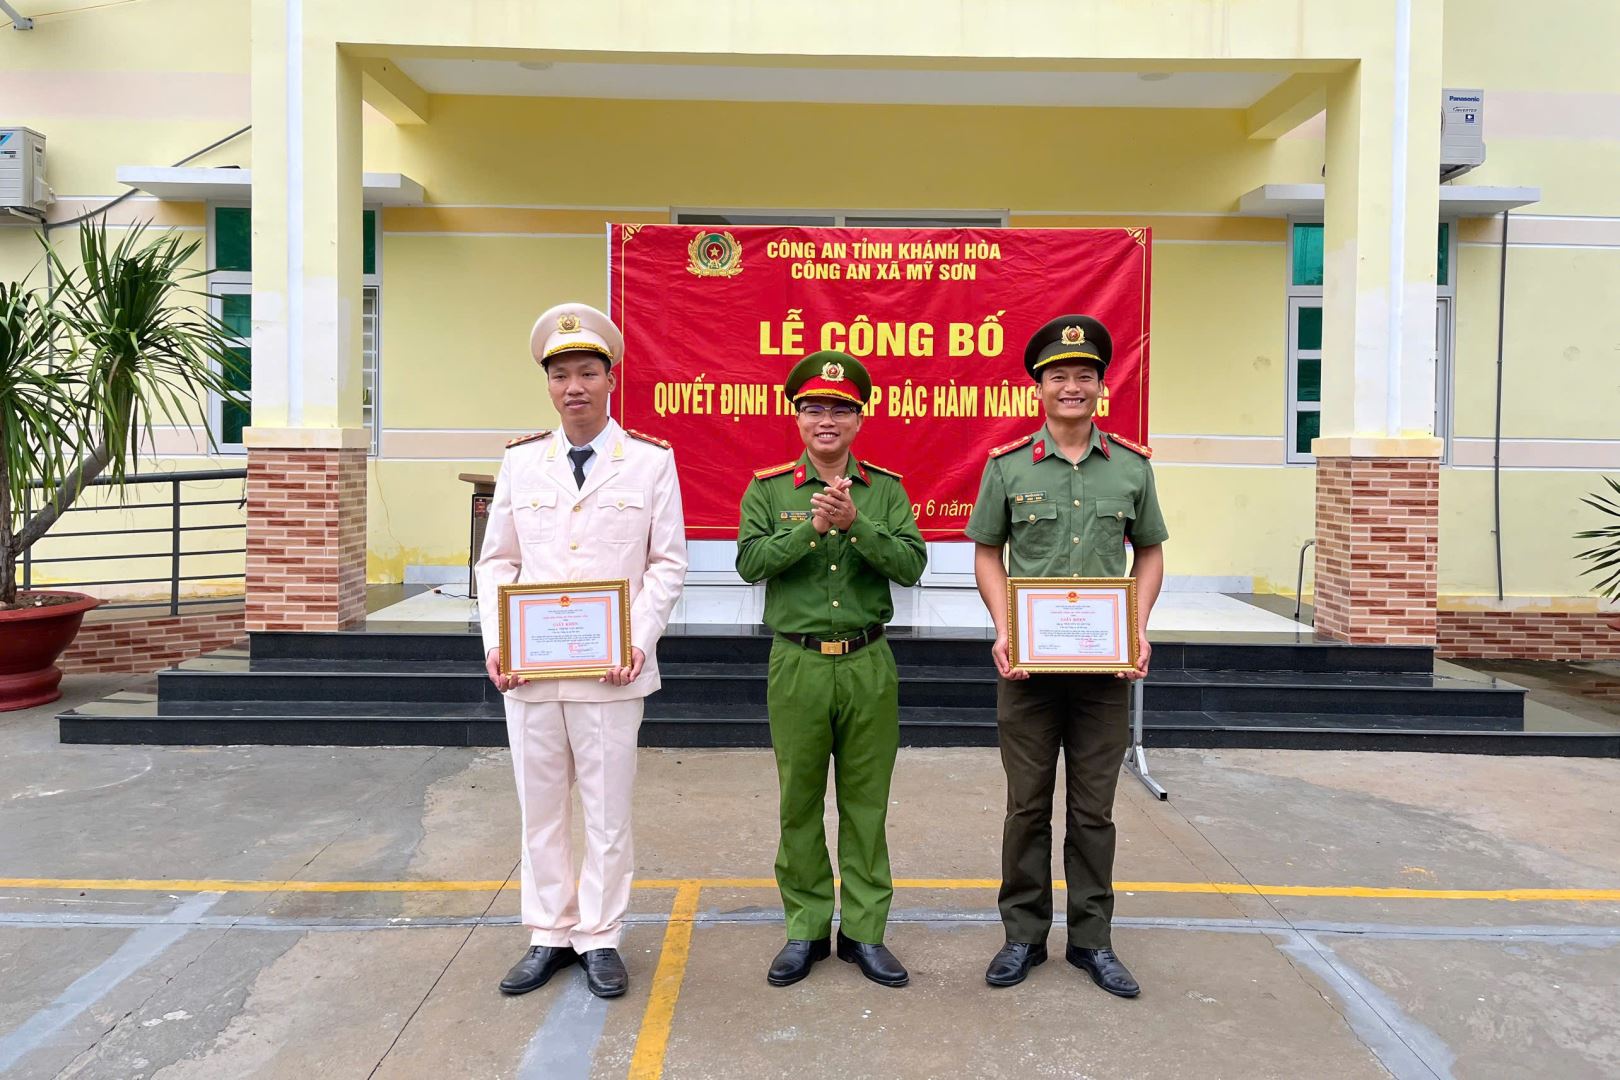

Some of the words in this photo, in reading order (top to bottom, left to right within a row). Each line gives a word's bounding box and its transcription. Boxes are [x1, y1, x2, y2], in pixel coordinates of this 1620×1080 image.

[767, 239, 816, 259] CÔNG
[821, 243, 846, 259] AN
[852, 238, 893, 260] TỈNH
[898, 239, 960, 260] KHÁNH
[964, 239, 1002, 260] HÒA
[791, 260, 841, 280] CÔNG
[846, 263, 871, 280] AN
[876, 261, 900, 280] XÃ
[906, 260, 934, 281] MỸ
[938, 263, 976, 281] SƠN
[759, 308, 805, 355] LỄ
[820, 314, 934, 357] CÔNG
[948, 309, 1007, 358] BỐ
[654, 372, 715, 418] QUYẾT
[719, 383, 768, 422] ĐỊNH
[888, 379, 927, 424] BẬC
[933, 379, 978, 417] HÀM
[984, 379, 1039, 417] NÂNG
[926, 499, 936, 516] 6
[939, 500, 974, 517] năm
